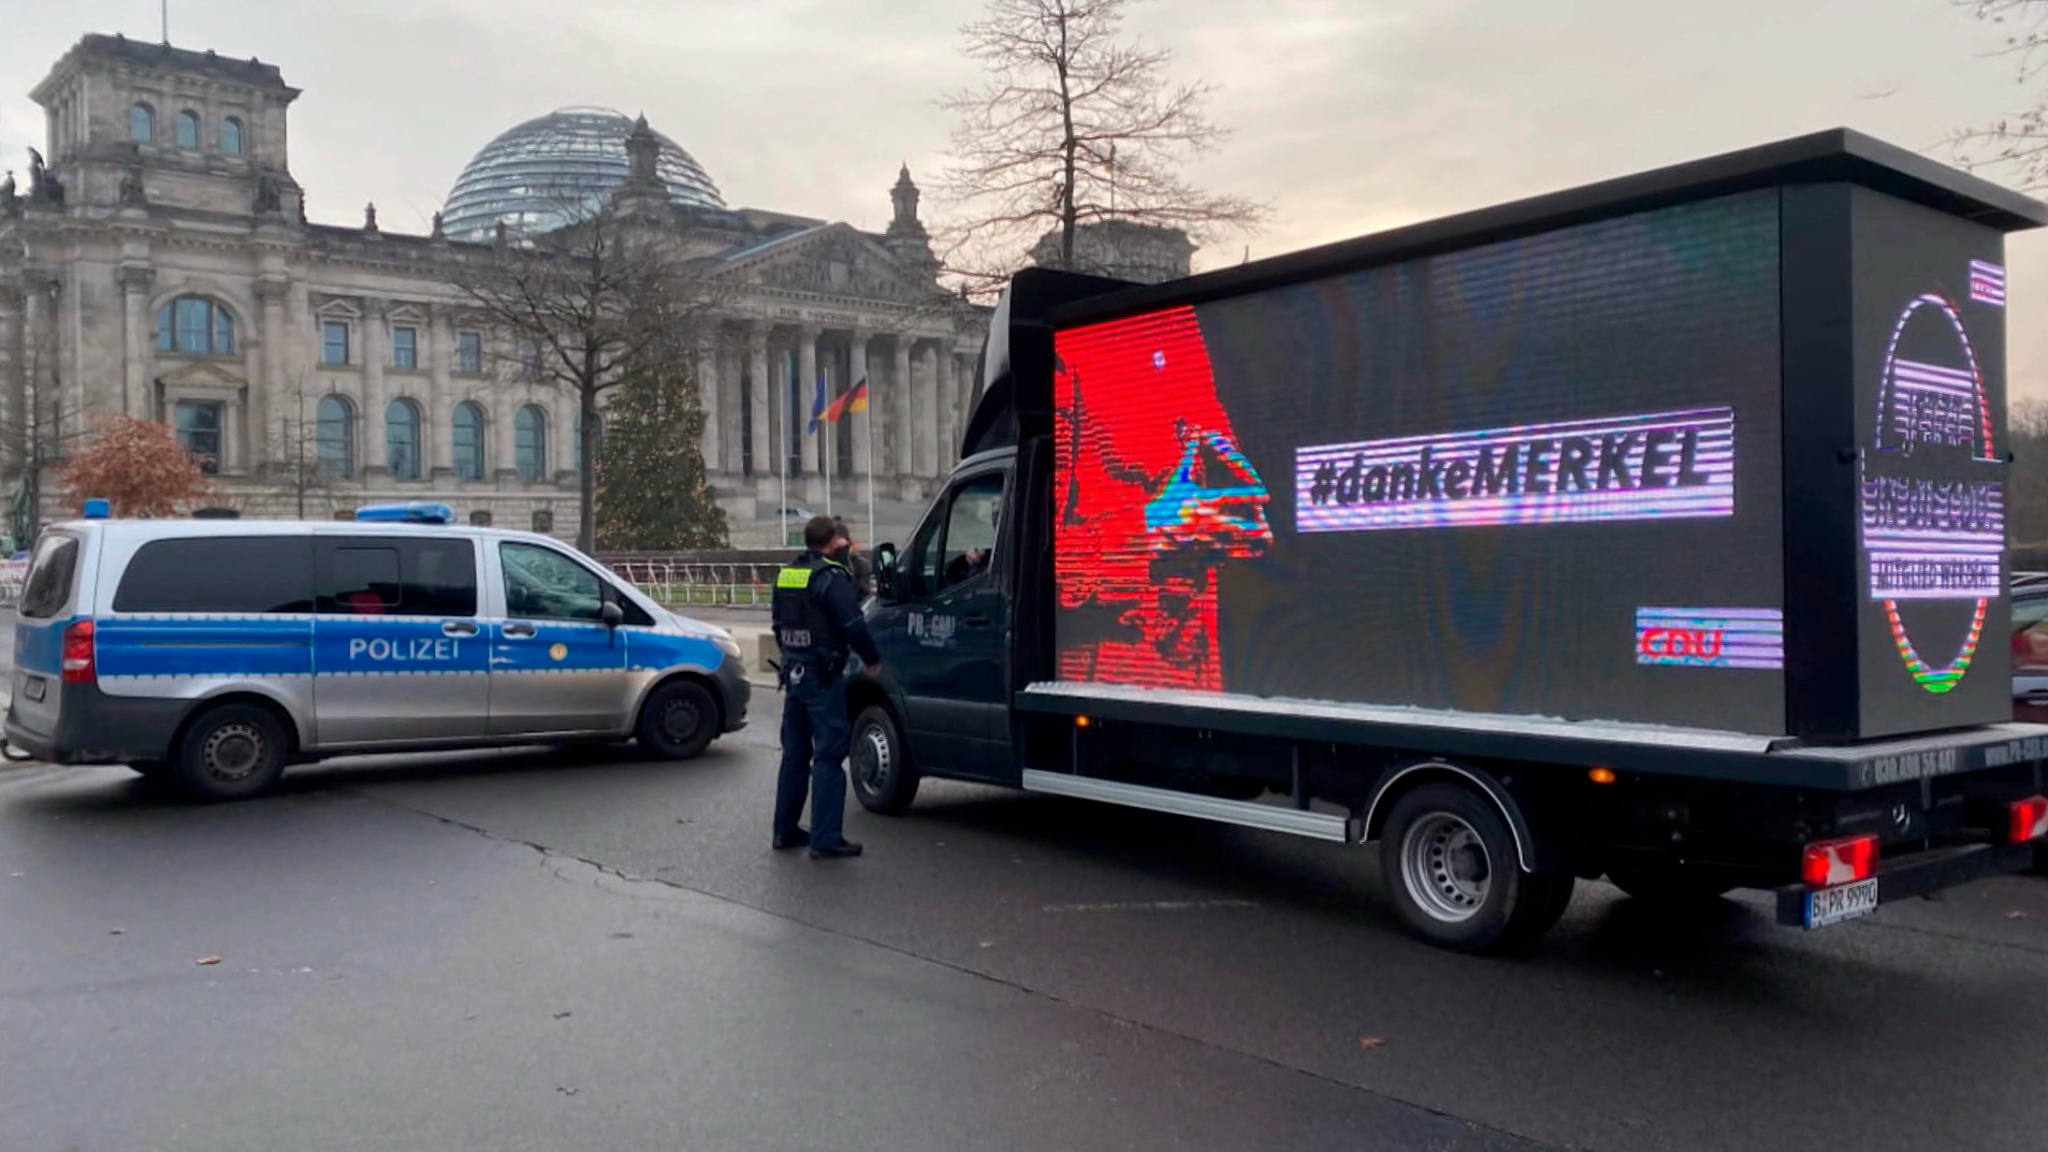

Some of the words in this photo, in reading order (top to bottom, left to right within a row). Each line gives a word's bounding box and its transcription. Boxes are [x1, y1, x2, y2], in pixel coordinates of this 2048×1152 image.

[1309, 427, 1710, 506] #dankeMERKEL
[349, 638, 459, 660] POLIZEI
[1641, 627, 1722, 660] CDU
